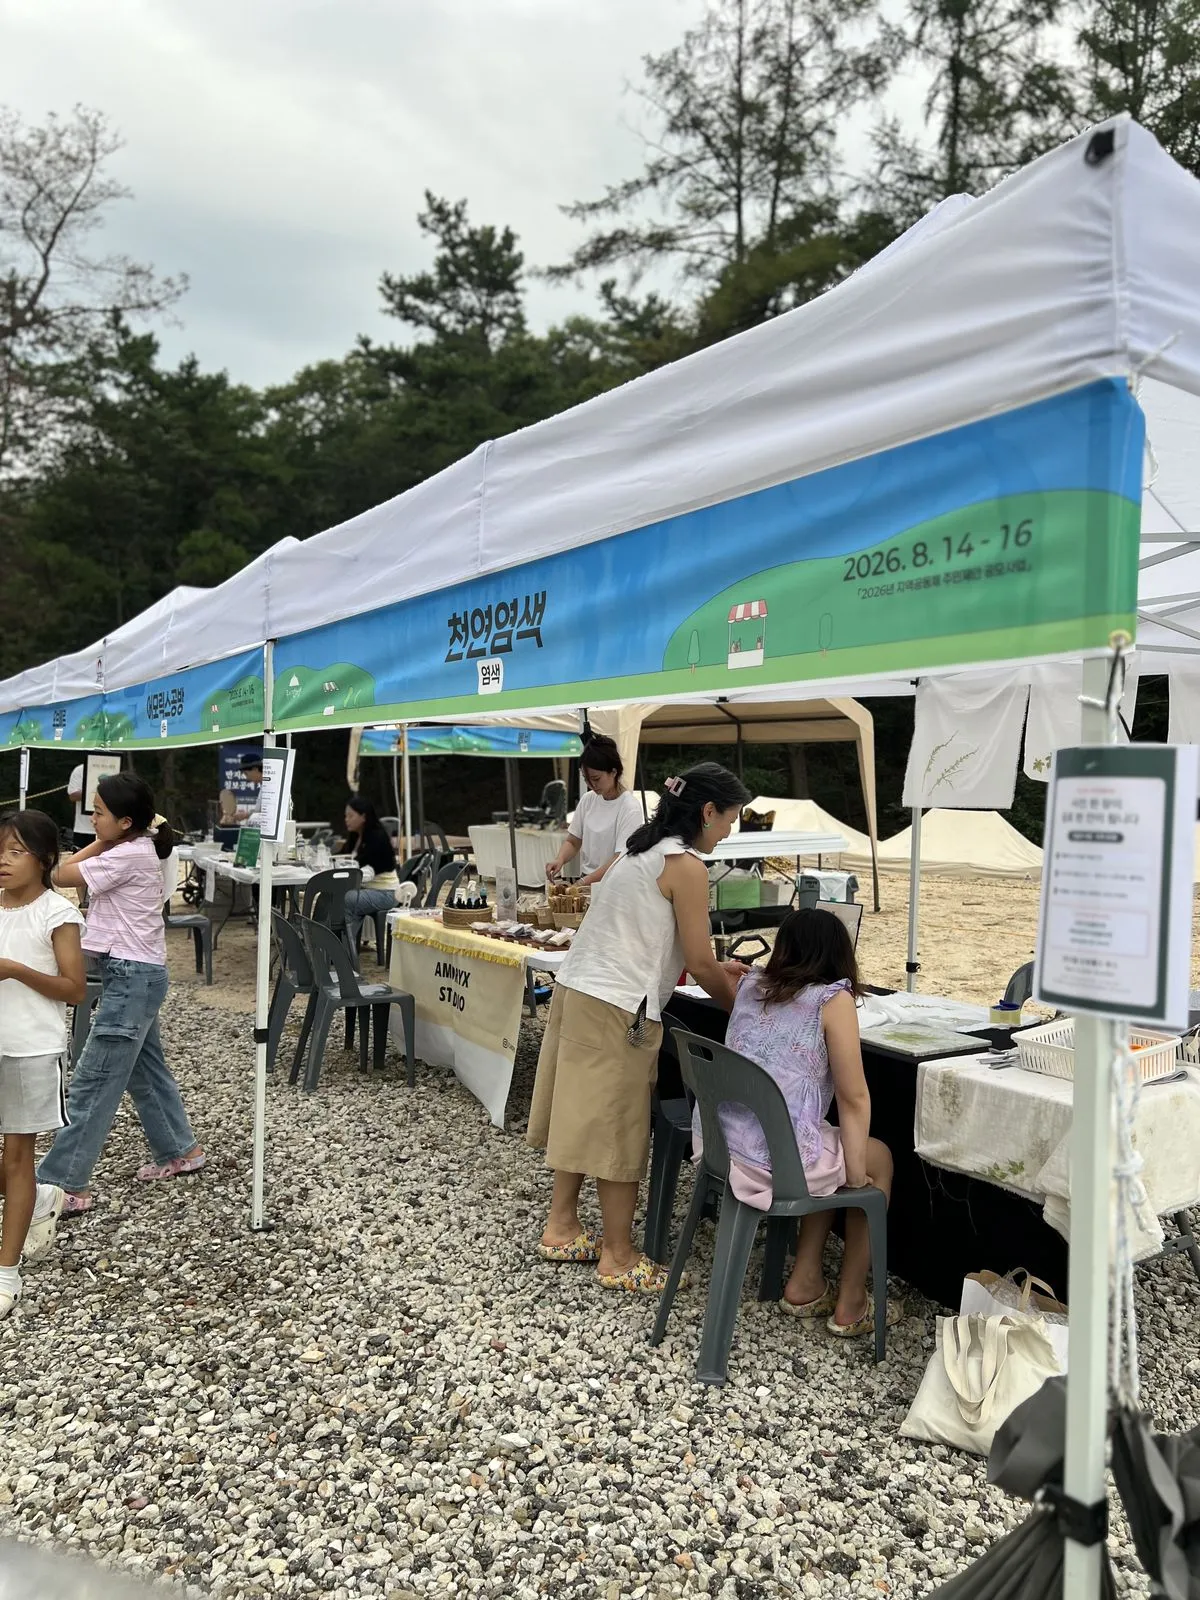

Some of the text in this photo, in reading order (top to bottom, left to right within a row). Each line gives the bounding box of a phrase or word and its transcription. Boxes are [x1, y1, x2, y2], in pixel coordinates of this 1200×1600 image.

[843, 547, 906, 581] 2026.
[912, 542, 934, 568] 8.
[445, 590, 547, 663] 천연염색
[481, 663, 501, 686] 염색
